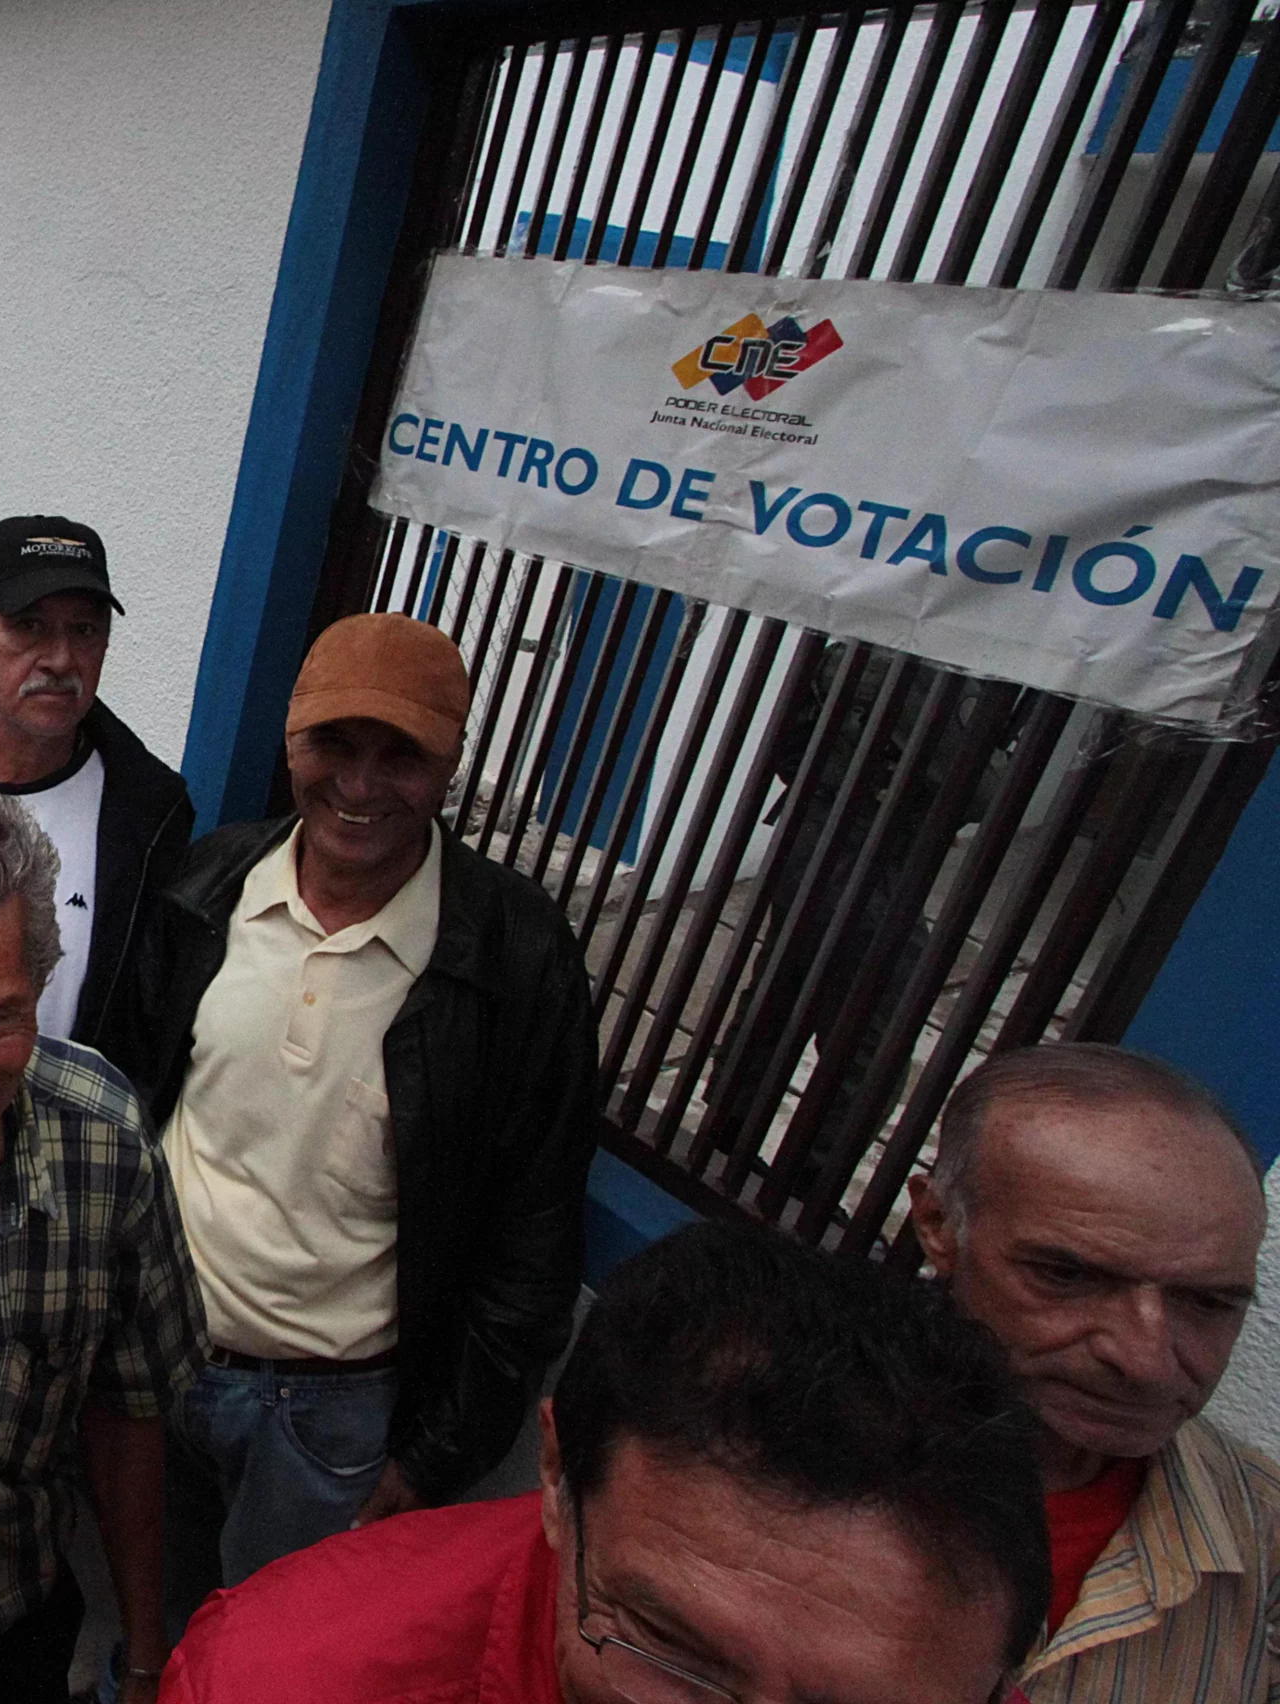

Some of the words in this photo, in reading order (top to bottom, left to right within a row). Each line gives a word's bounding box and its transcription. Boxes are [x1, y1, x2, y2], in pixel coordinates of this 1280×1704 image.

[650, 410, 687, 426] Junta
[690, 416, 748, 435] Nacional
[751, 425, 818, 446] Electoral
[664, 396, 718, 412] PODER
[720, 404, 813, 427] ELECTORAL
[387, 412, 599, 497] CENTRO
[616, 459, 717, 522] DE
[748, 479, 1263, 633] VOTACIÓN
